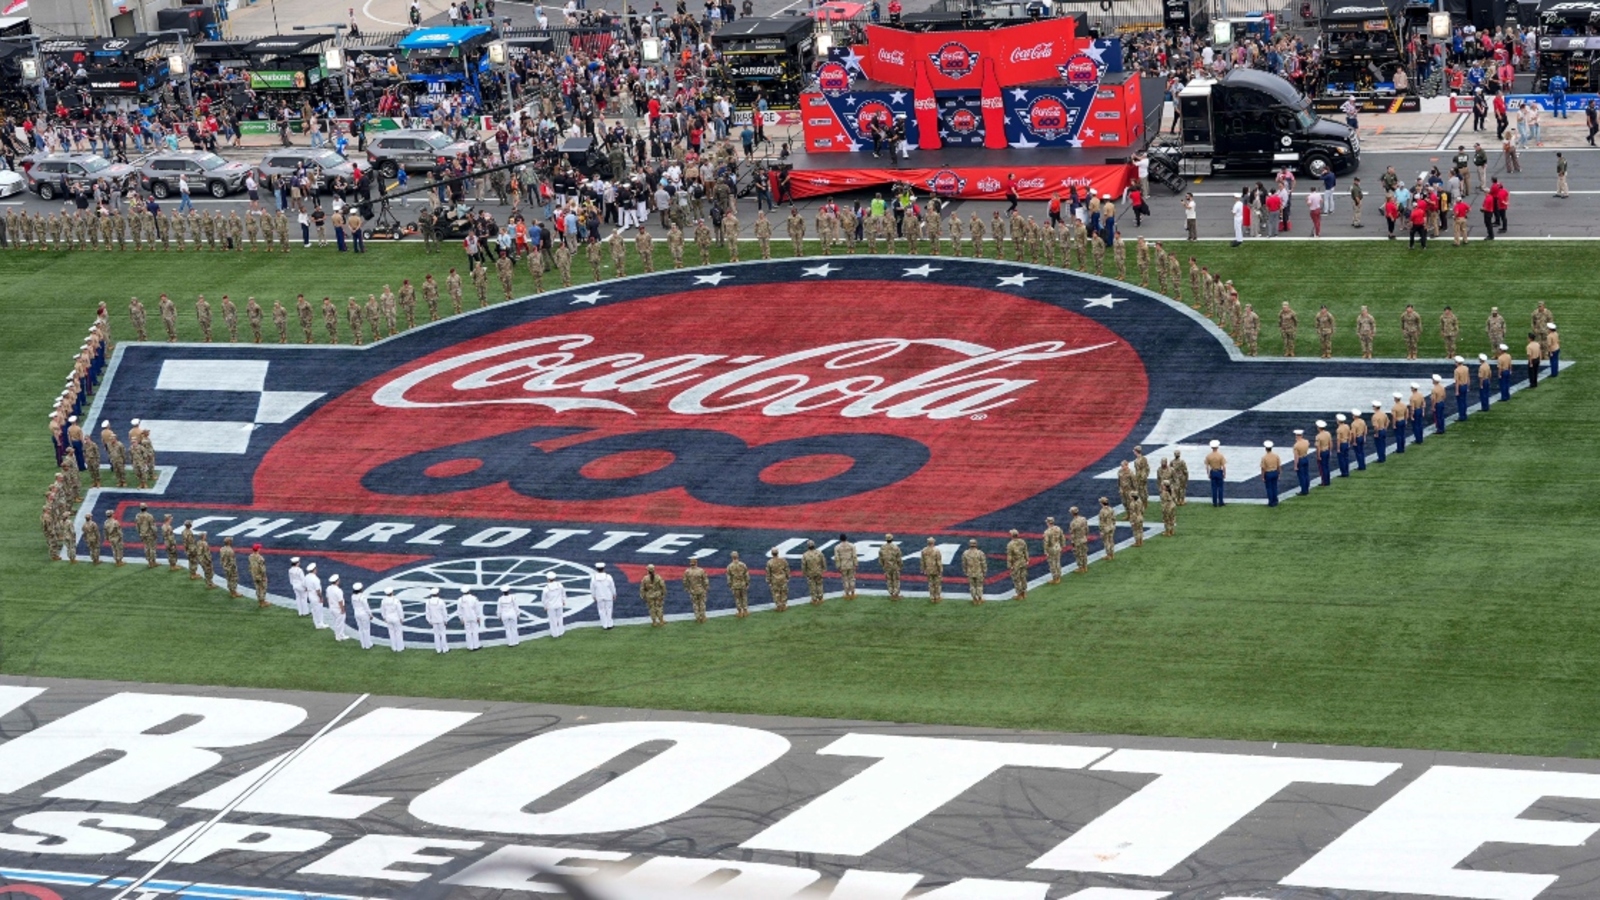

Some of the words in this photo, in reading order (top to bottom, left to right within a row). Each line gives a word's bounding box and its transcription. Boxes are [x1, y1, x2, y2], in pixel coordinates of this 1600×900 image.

[946, 60, 964, 68] 600
[1010, 42, 1054, 63] Coca-Cola
[1031, 106, 1062, 117] Coca-Cola
[1038, 117, 1060, 126] 600
[372, 334, 1117, 420] Coca-Cola
[360, 425, 930, 508] 600
[765, 537, 962, 566] USA
[0, 687, 1600, 898] RLOTTE
